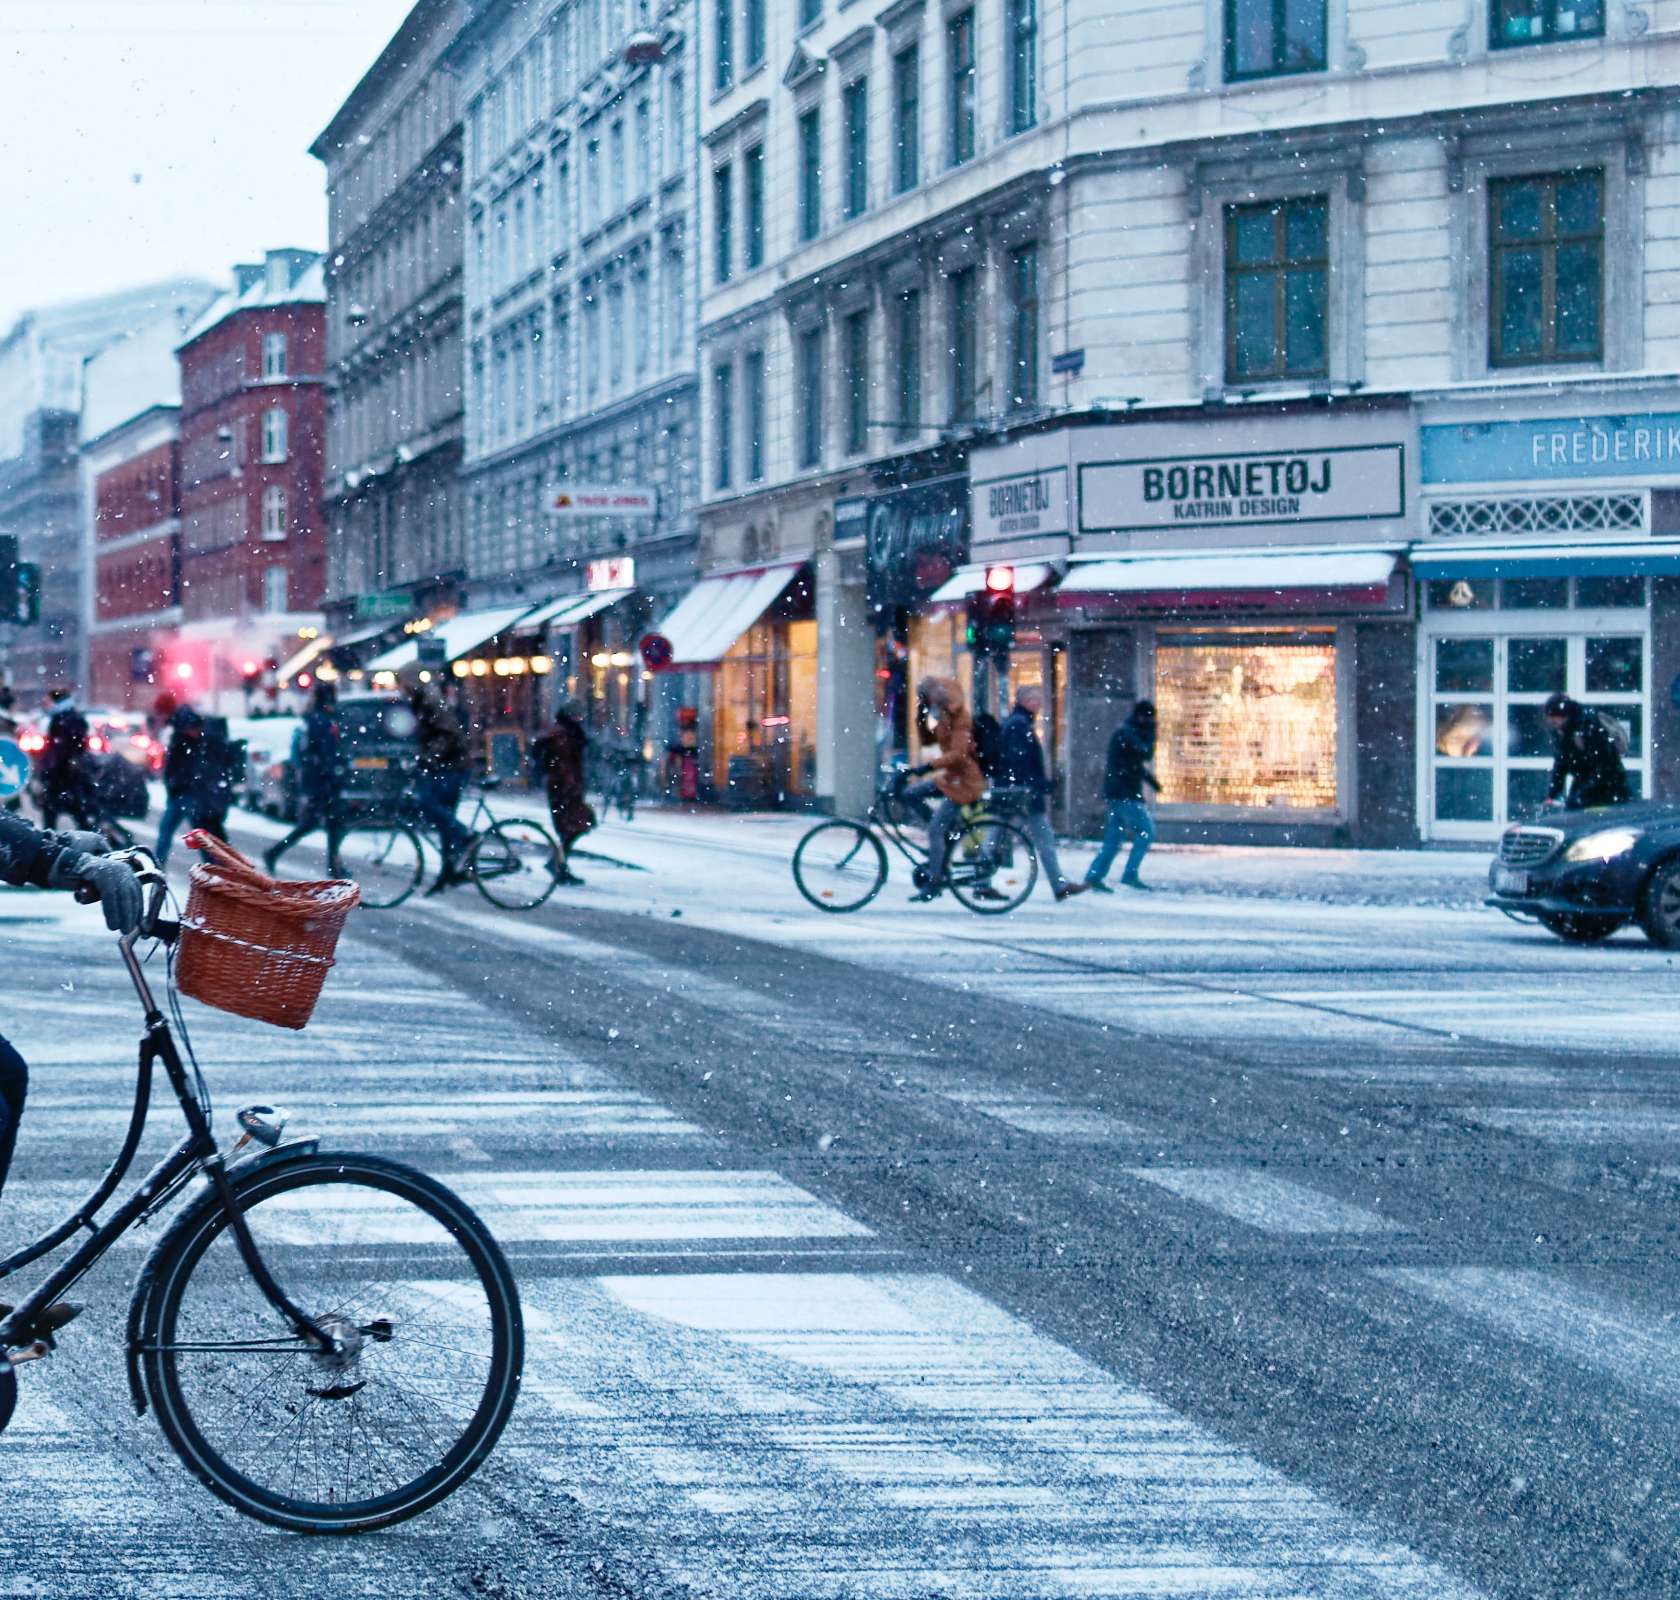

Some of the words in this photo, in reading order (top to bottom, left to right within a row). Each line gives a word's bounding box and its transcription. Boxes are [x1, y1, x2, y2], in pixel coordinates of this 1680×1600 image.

[1532, 426, 1680, 465] FREDERIK
[1143, 459, 1331, 502] BØRNETØJ
[1174, 500, 1232, 519] KATRIN
[1239, 498, 1300, 515] DESIGN
